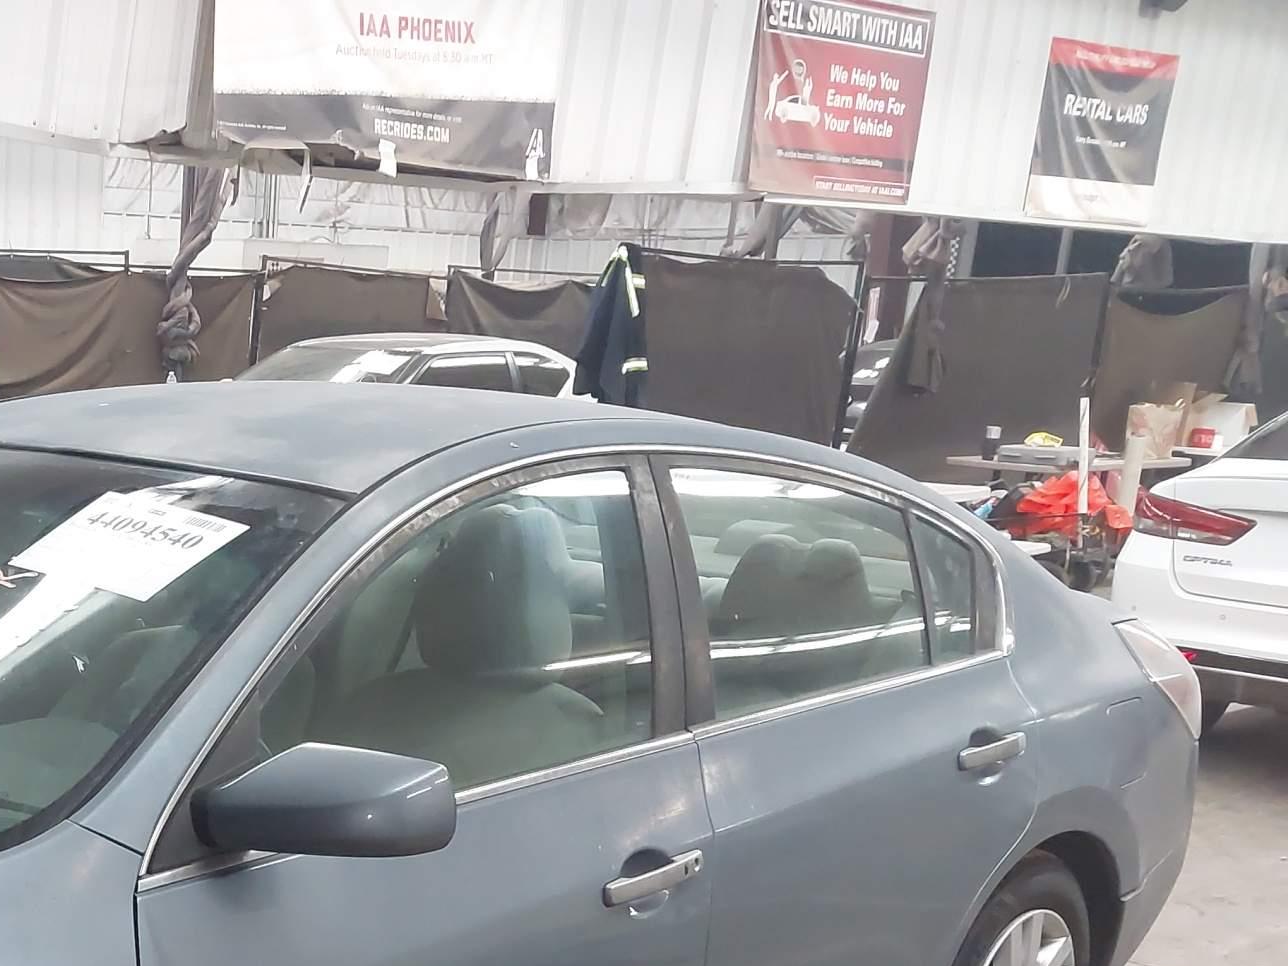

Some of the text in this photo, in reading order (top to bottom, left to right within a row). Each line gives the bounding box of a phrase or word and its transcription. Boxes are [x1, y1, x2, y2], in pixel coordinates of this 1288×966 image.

[359, 11, 476, 45] IAA PHOENIX
[768, 0, 923, 51] SELL SMART WITH IAA
[829, 63, 900, 91] We Help You
[826, 90, 906, 116] Earn More For
[1063, 93, 1150, 125] RENTAL CARS
[374, 118, 450, 144] RECRIDES.COM
[824, 112, 893, 138] Your Vehicle
[87, 511, 204, 550] 44094540
